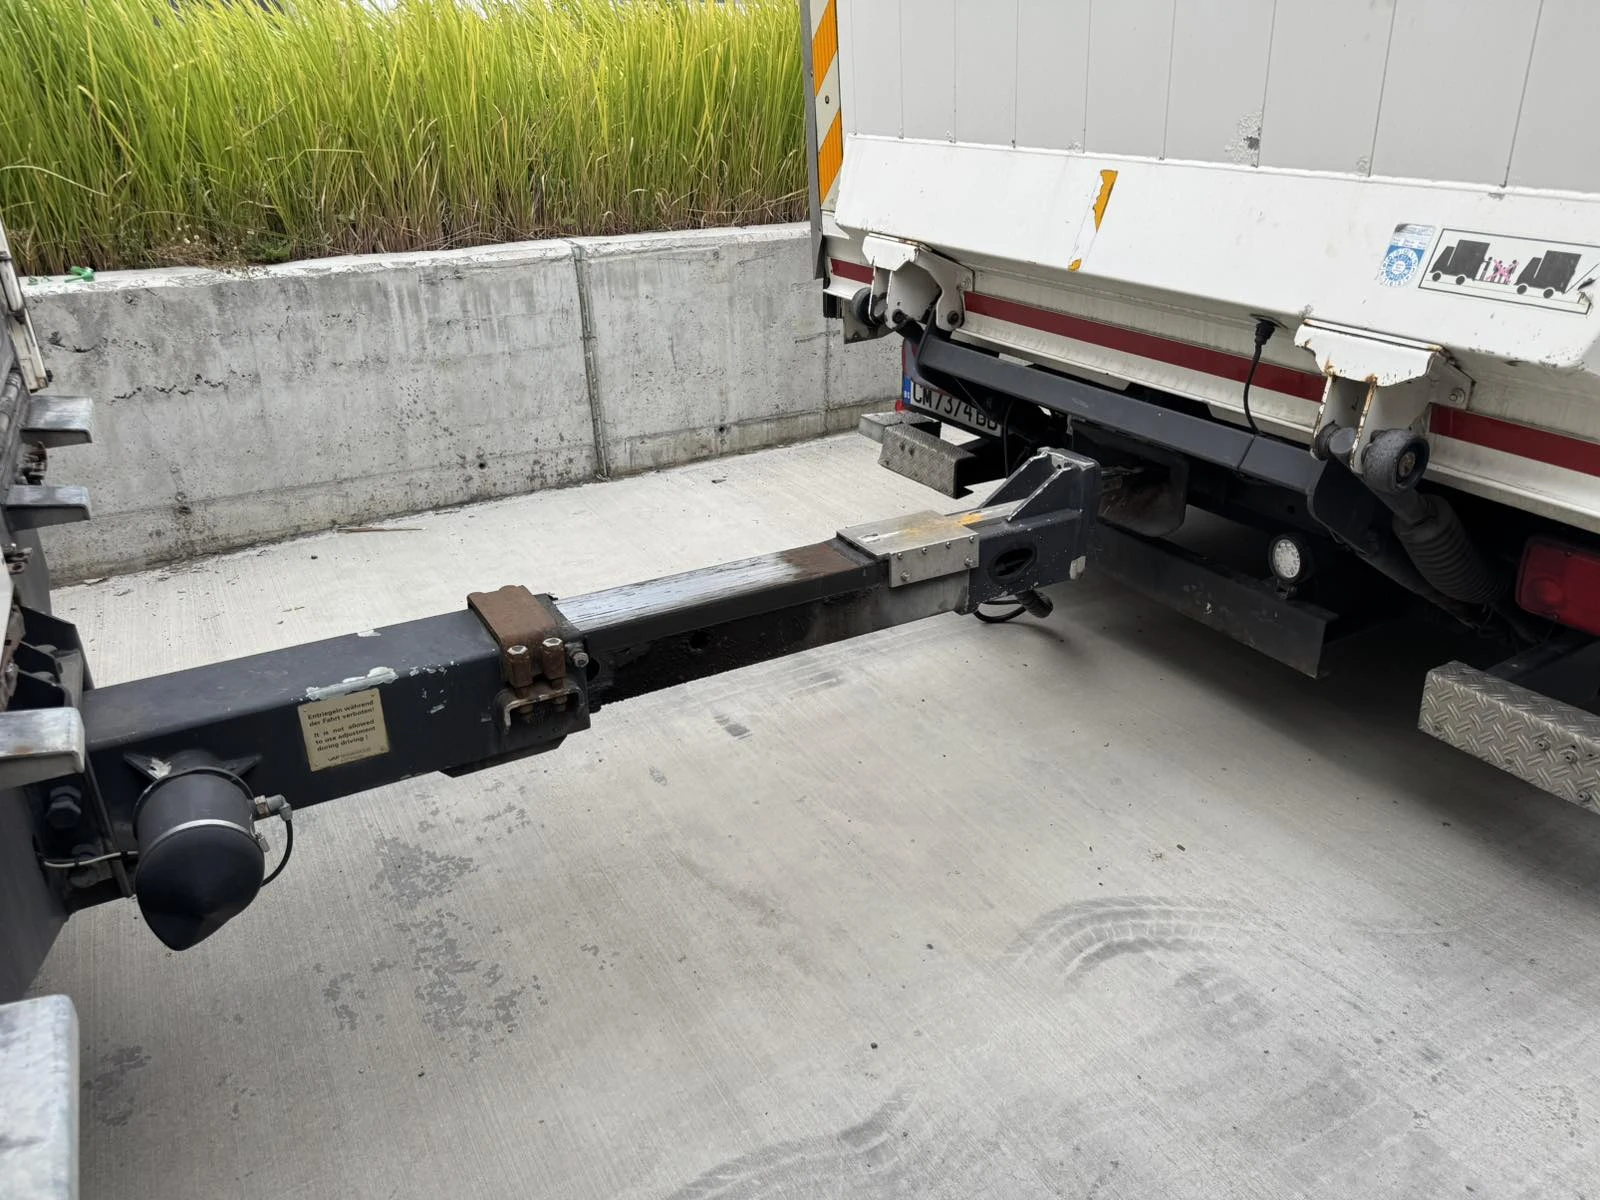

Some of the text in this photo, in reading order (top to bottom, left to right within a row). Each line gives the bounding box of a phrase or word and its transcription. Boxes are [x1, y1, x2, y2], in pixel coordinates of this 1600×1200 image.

[307, 708, 342, 720] Entriegeln
[323, 715, 340, 724] Fahrt
[348, 719, 374, 730] allowed
[338, 726, 376, 740] adjustment
[317, 742, 339, 752] during
[340, 736, 364, 746] driving
